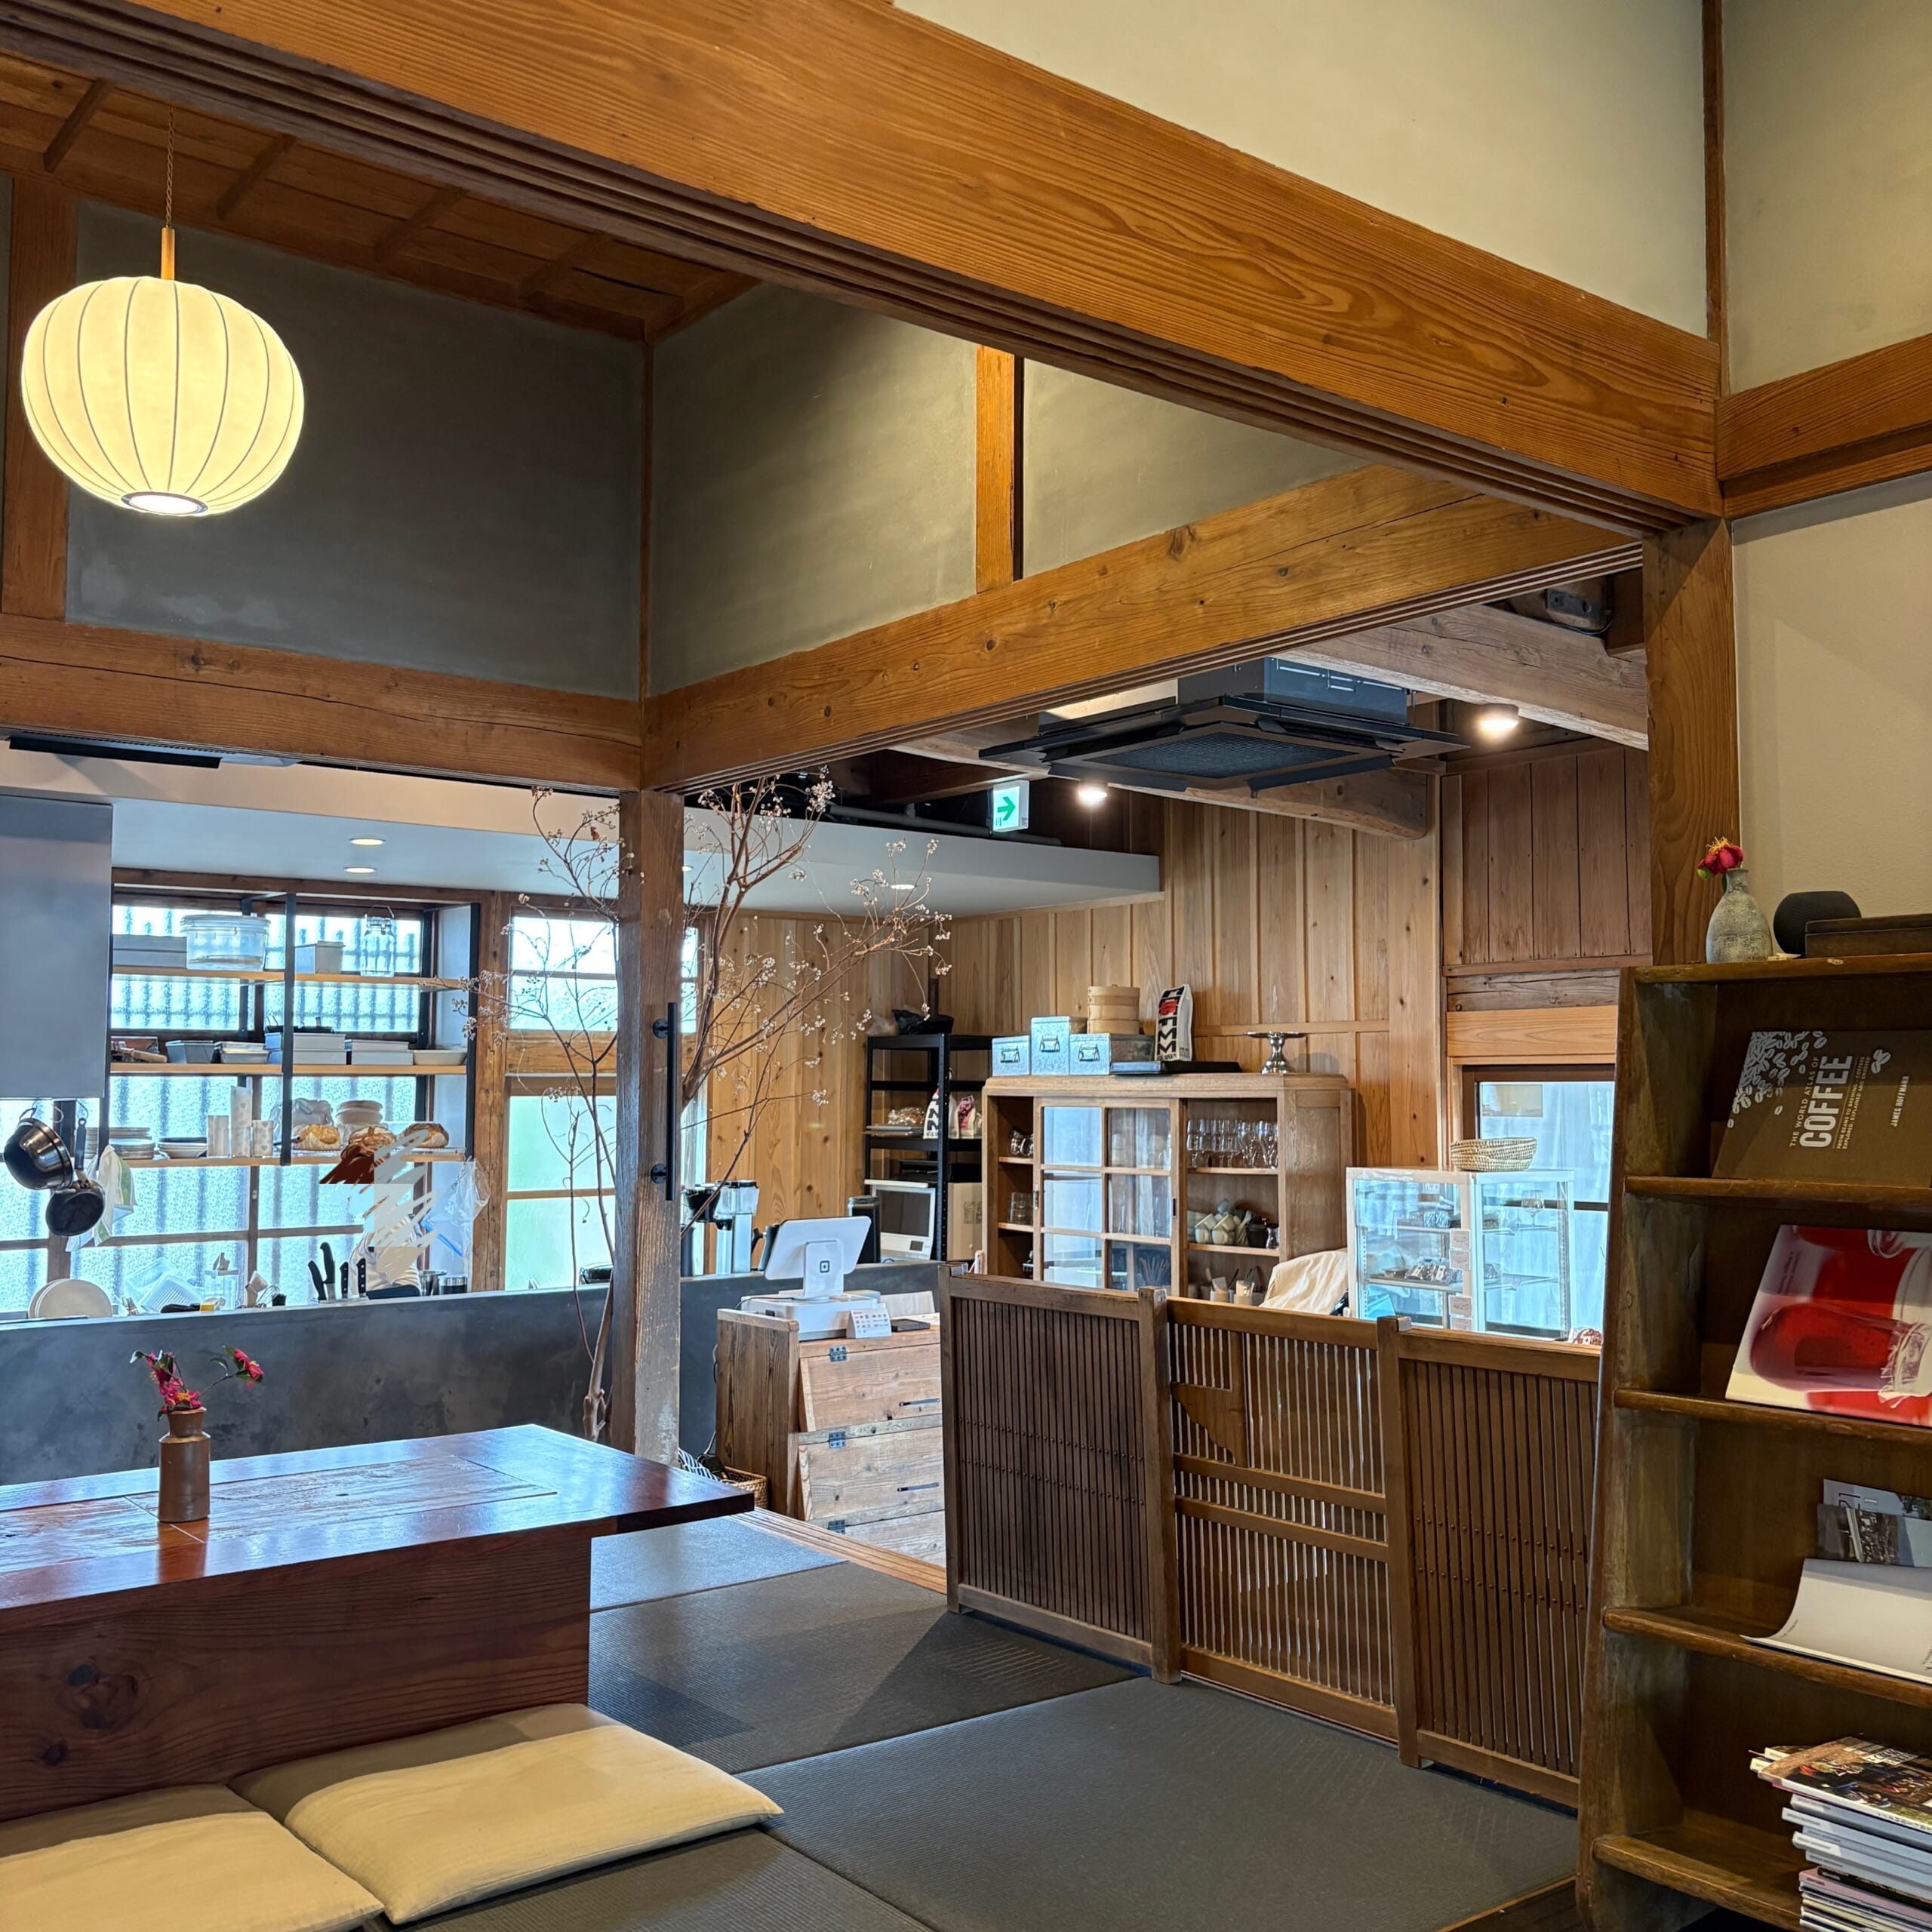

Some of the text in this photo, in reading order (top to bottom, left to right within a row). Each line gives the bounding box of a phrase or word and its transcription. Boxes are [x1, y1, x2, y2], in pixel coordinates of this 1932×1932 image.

[1789, 1057, 1819, 1147] THE WORLD ATLAS OF
[1799, 1056, 1853, 1147] COFFEE
[1890, 1075, 1909, 1127] JAMES HOFFMANN
[1836, 1134, 1844, 1149] FROM
